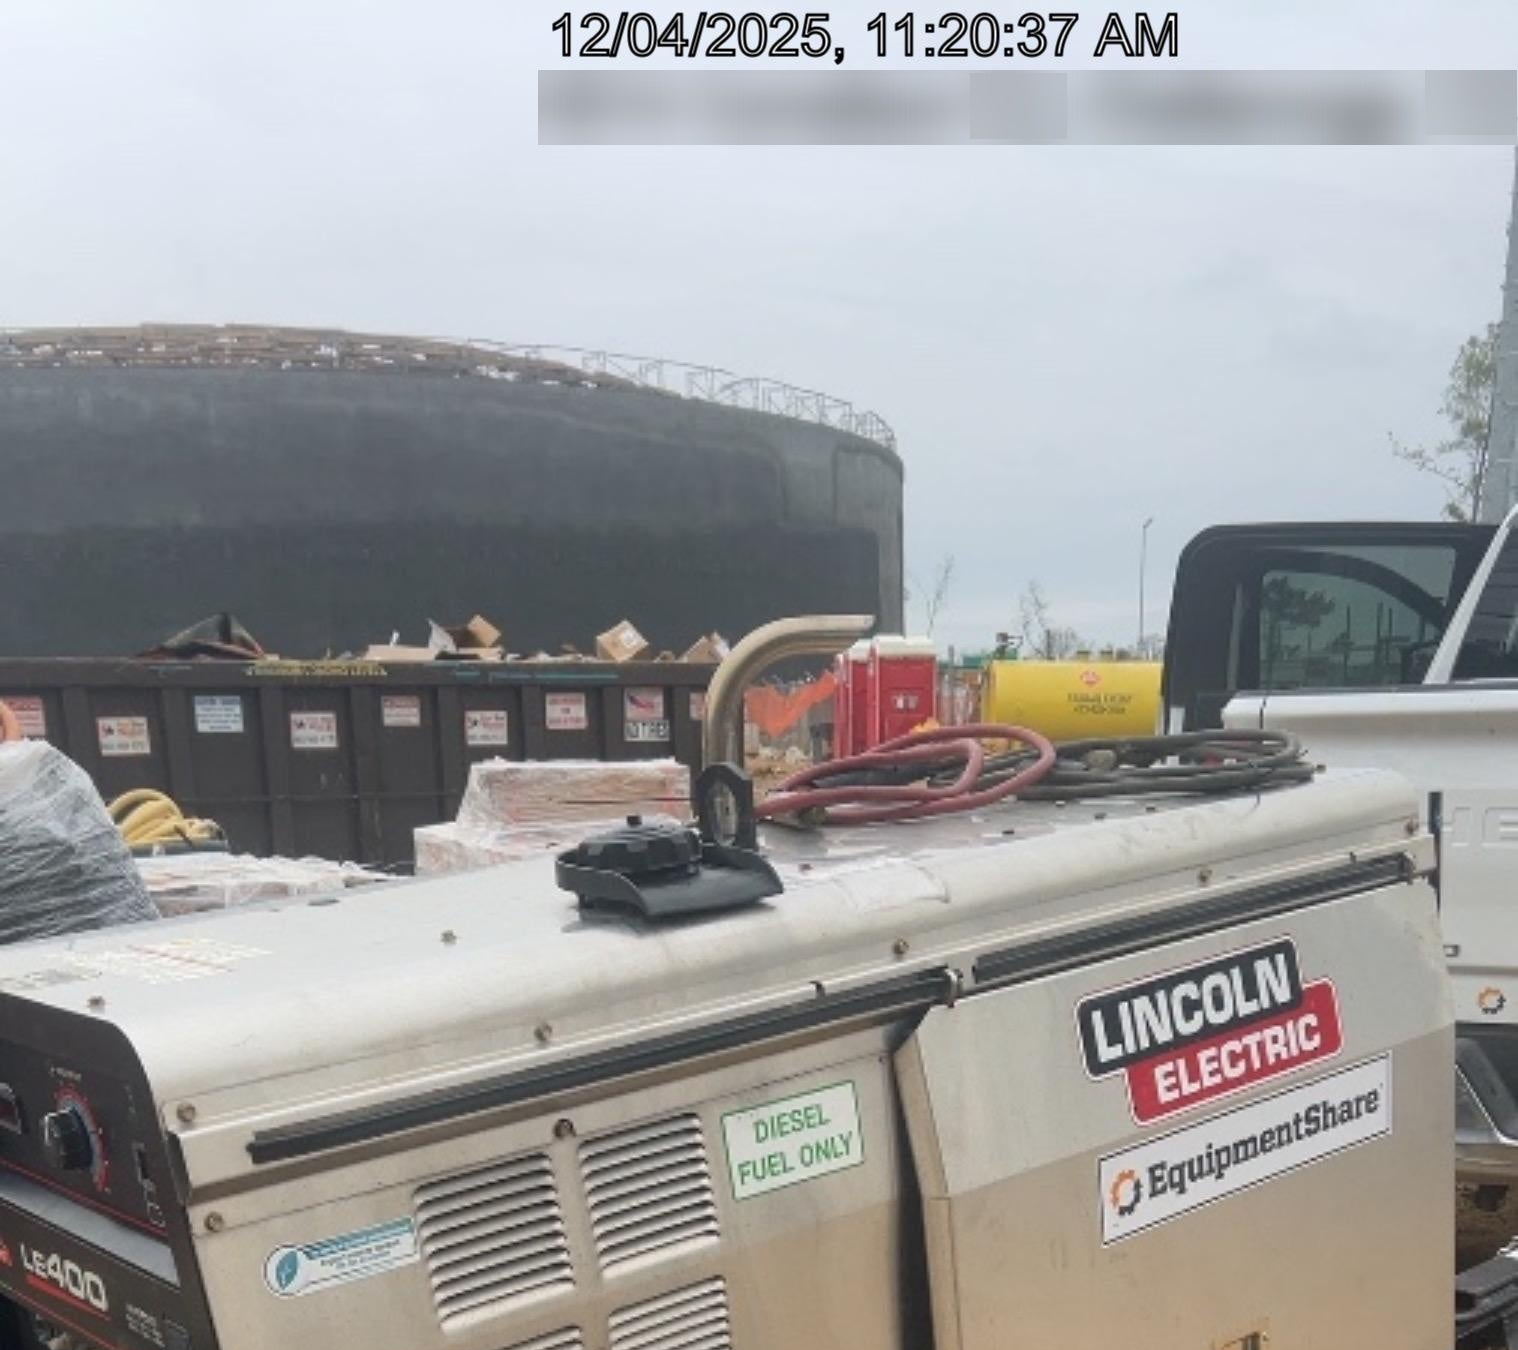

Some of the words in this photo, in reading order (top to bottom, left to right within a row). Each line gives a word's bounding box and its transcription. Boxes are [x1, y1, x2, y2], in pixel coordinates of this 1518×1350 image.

[1091, 951, 1292, 1064] LINCOLN
[1155, 1013, 1322, 1104] ELECTRIC
[738, 1151, 796, 1186] FUEL
[800, 1131, 853, 1167] ONLY
[754, 1104, 832, 1144] DIESEL
[1146, 1088, 1381, 1198] EquipmentShare
[20, 1243, 109, 1313] LE400
